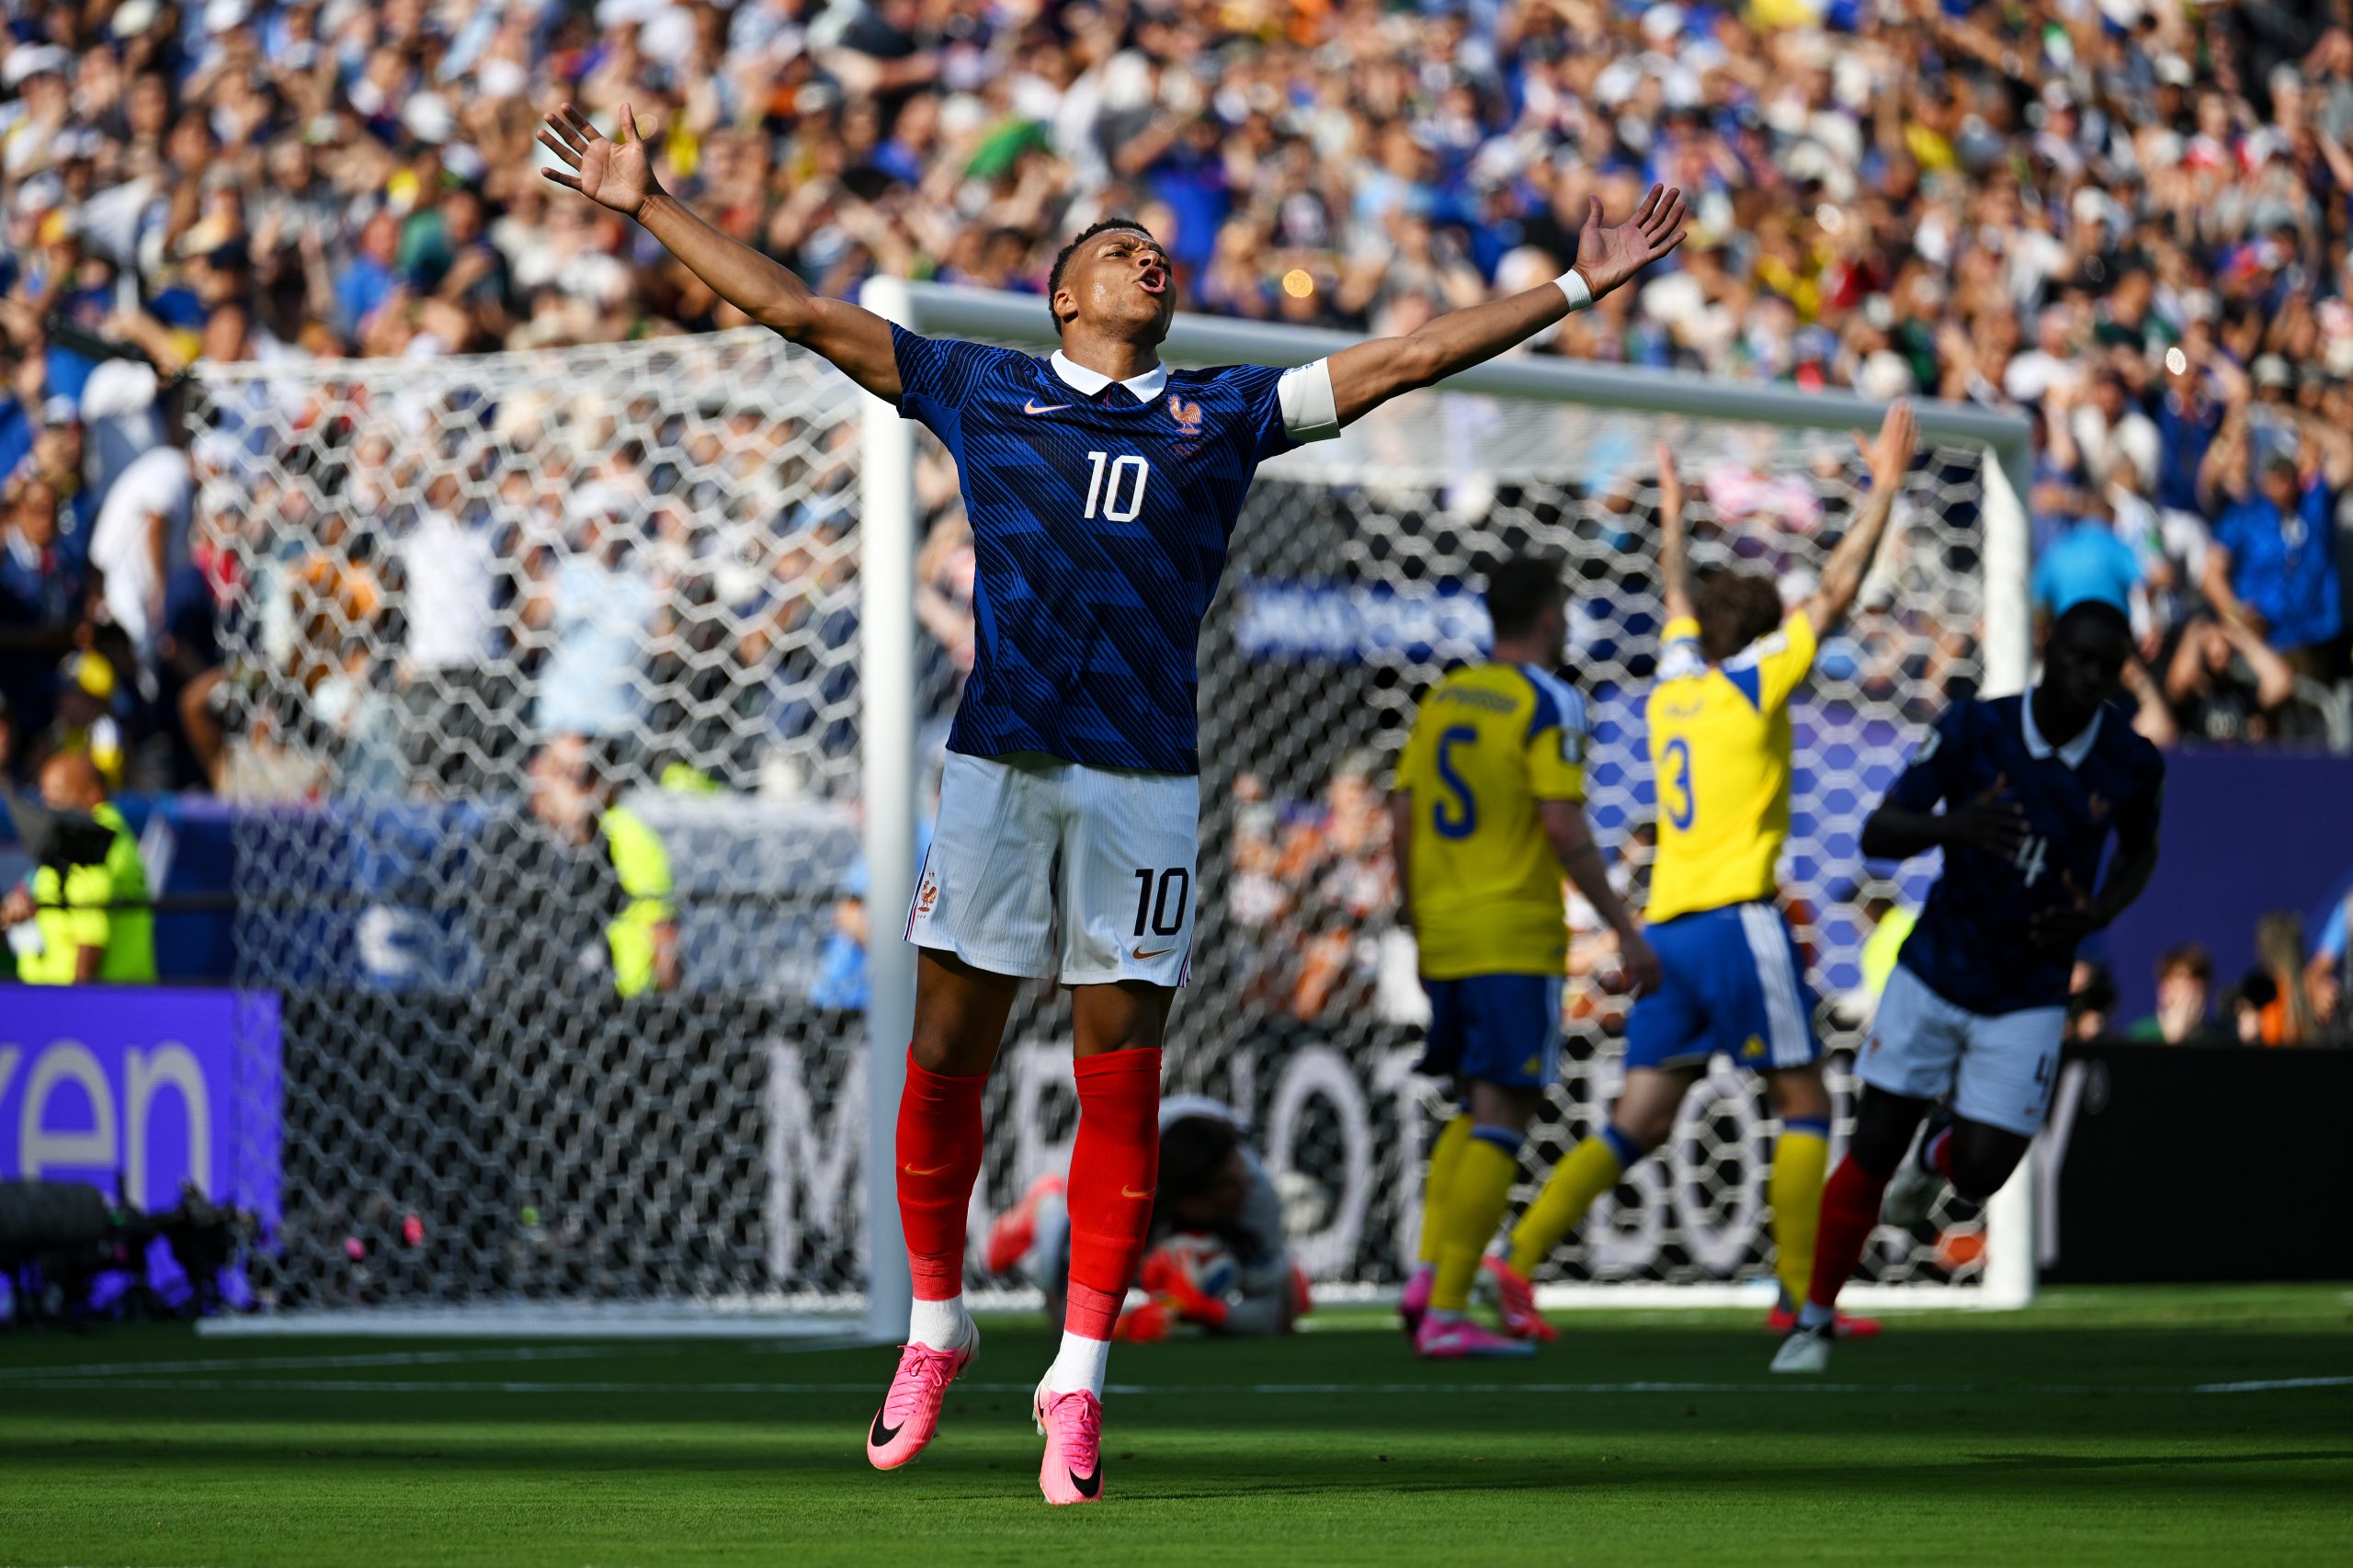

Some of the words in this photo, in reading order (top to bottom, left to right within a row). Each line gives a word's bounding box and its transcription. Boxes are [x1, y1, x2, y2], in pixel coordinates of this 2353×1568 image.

[1084, 451, 1149, 523] 10
[1434, 724, 1476, 838] 5
[1663, 738, 1693, 831] 3
[2017, 835, 2048, 888] 4
[1133, 868, 1189, 936] 10
